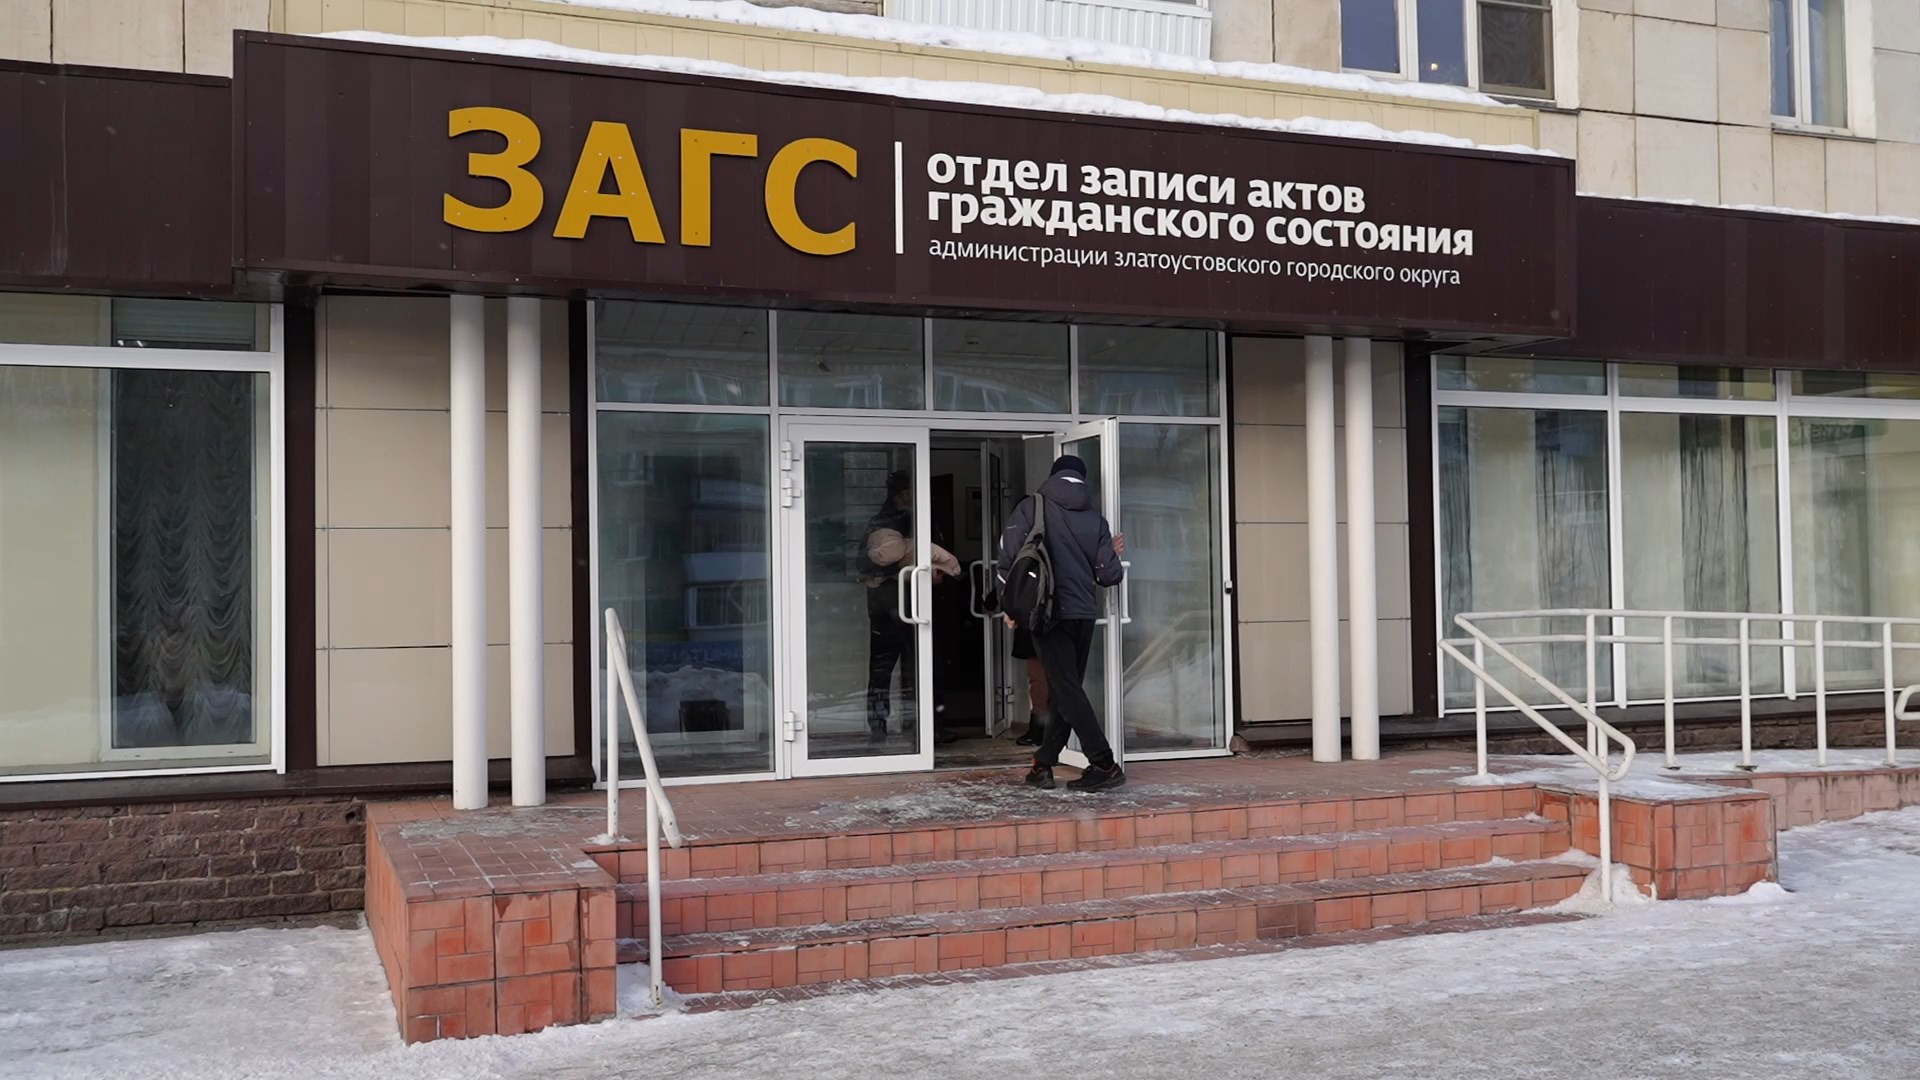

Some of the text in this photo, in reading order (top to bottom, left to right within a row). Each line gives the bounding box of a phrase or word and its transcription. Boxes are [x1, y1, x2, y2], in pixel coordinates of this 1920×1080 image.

[443, 106, 858, 256] ЗАГС
[927, 152, 1366, 214] отдел записи актов
[928, 190, 1474, 256] гражданского состояния
[928, 239, 1461, 289] администрации златоустовского городского округа
